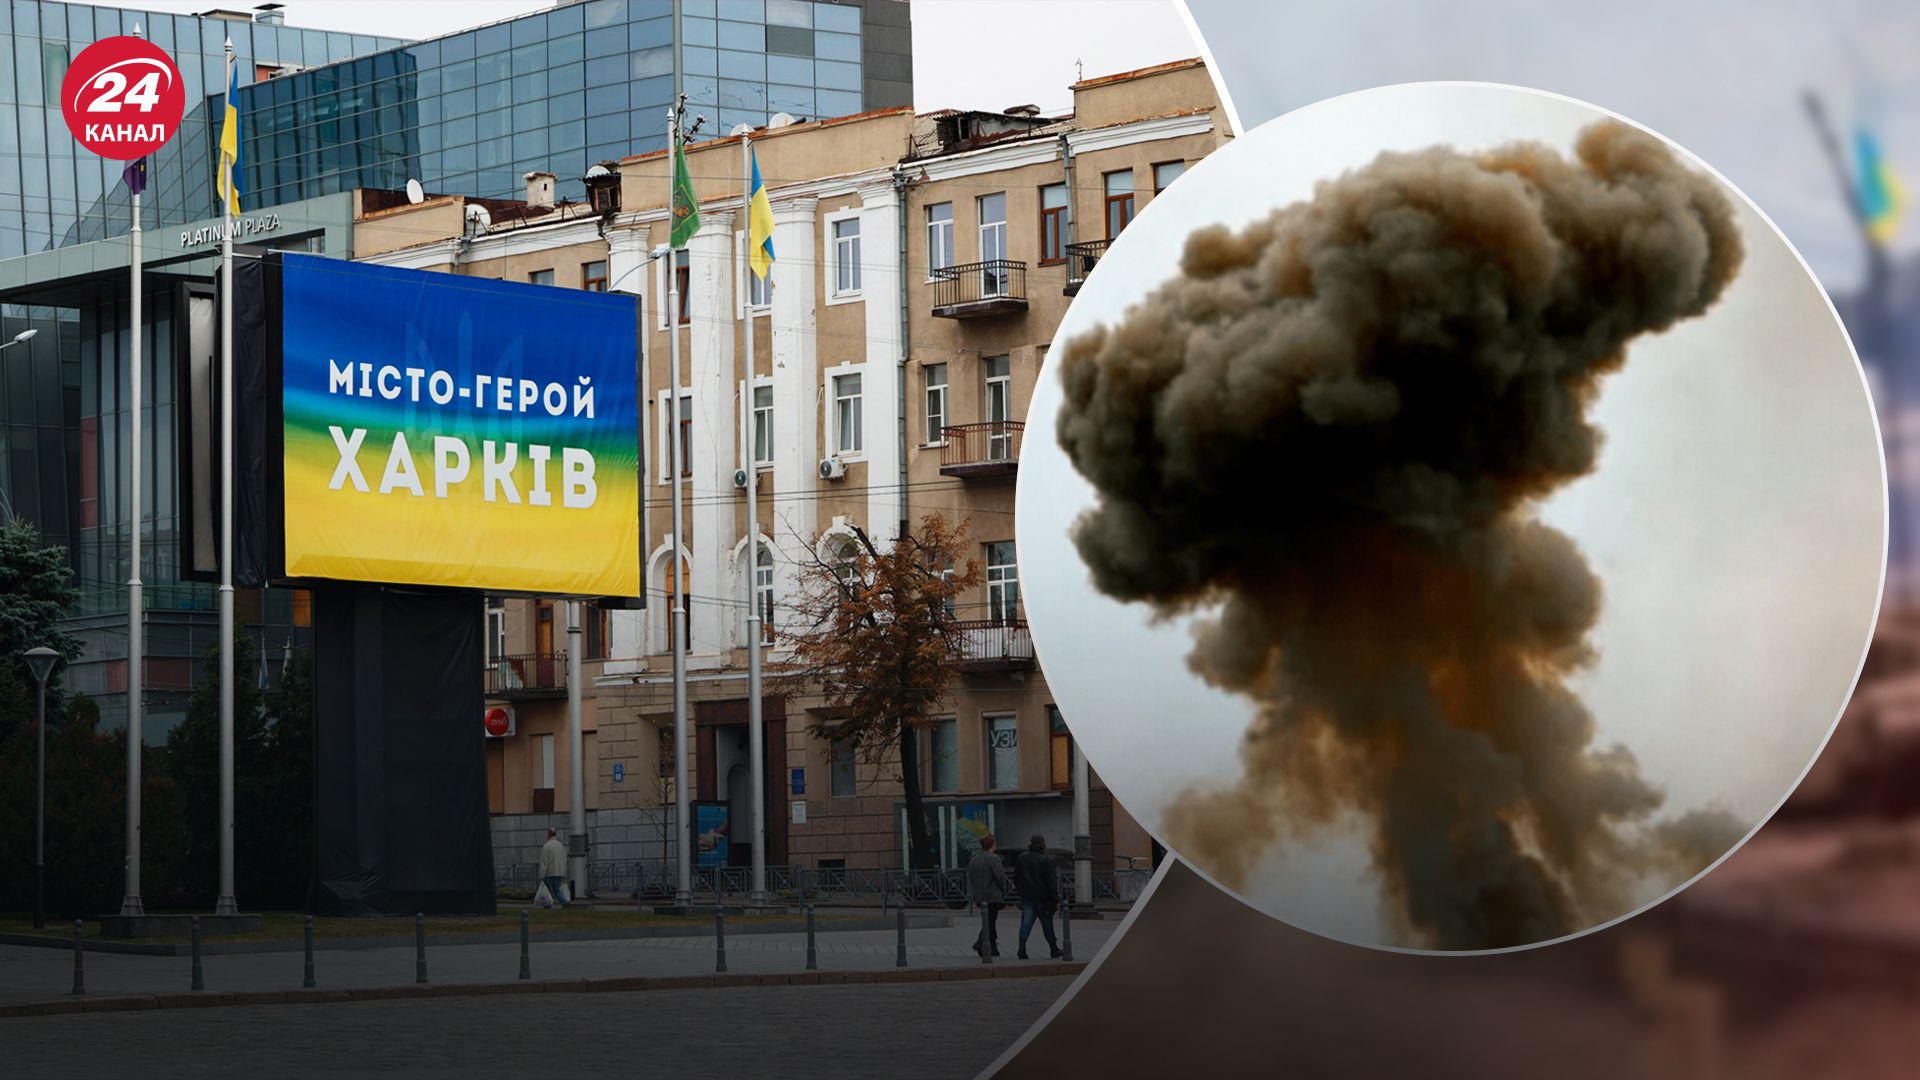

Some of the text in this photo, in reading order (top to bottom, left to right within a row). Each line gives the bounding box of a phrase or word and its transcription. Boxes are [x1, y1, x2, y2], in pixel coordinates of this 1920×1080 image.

[245, 213, 282, 235] PLAZA
[328, 358, 595, 419] МІСТО-ГЕРОЙ
[328, 425, 599, 510] ХАРКІВ
